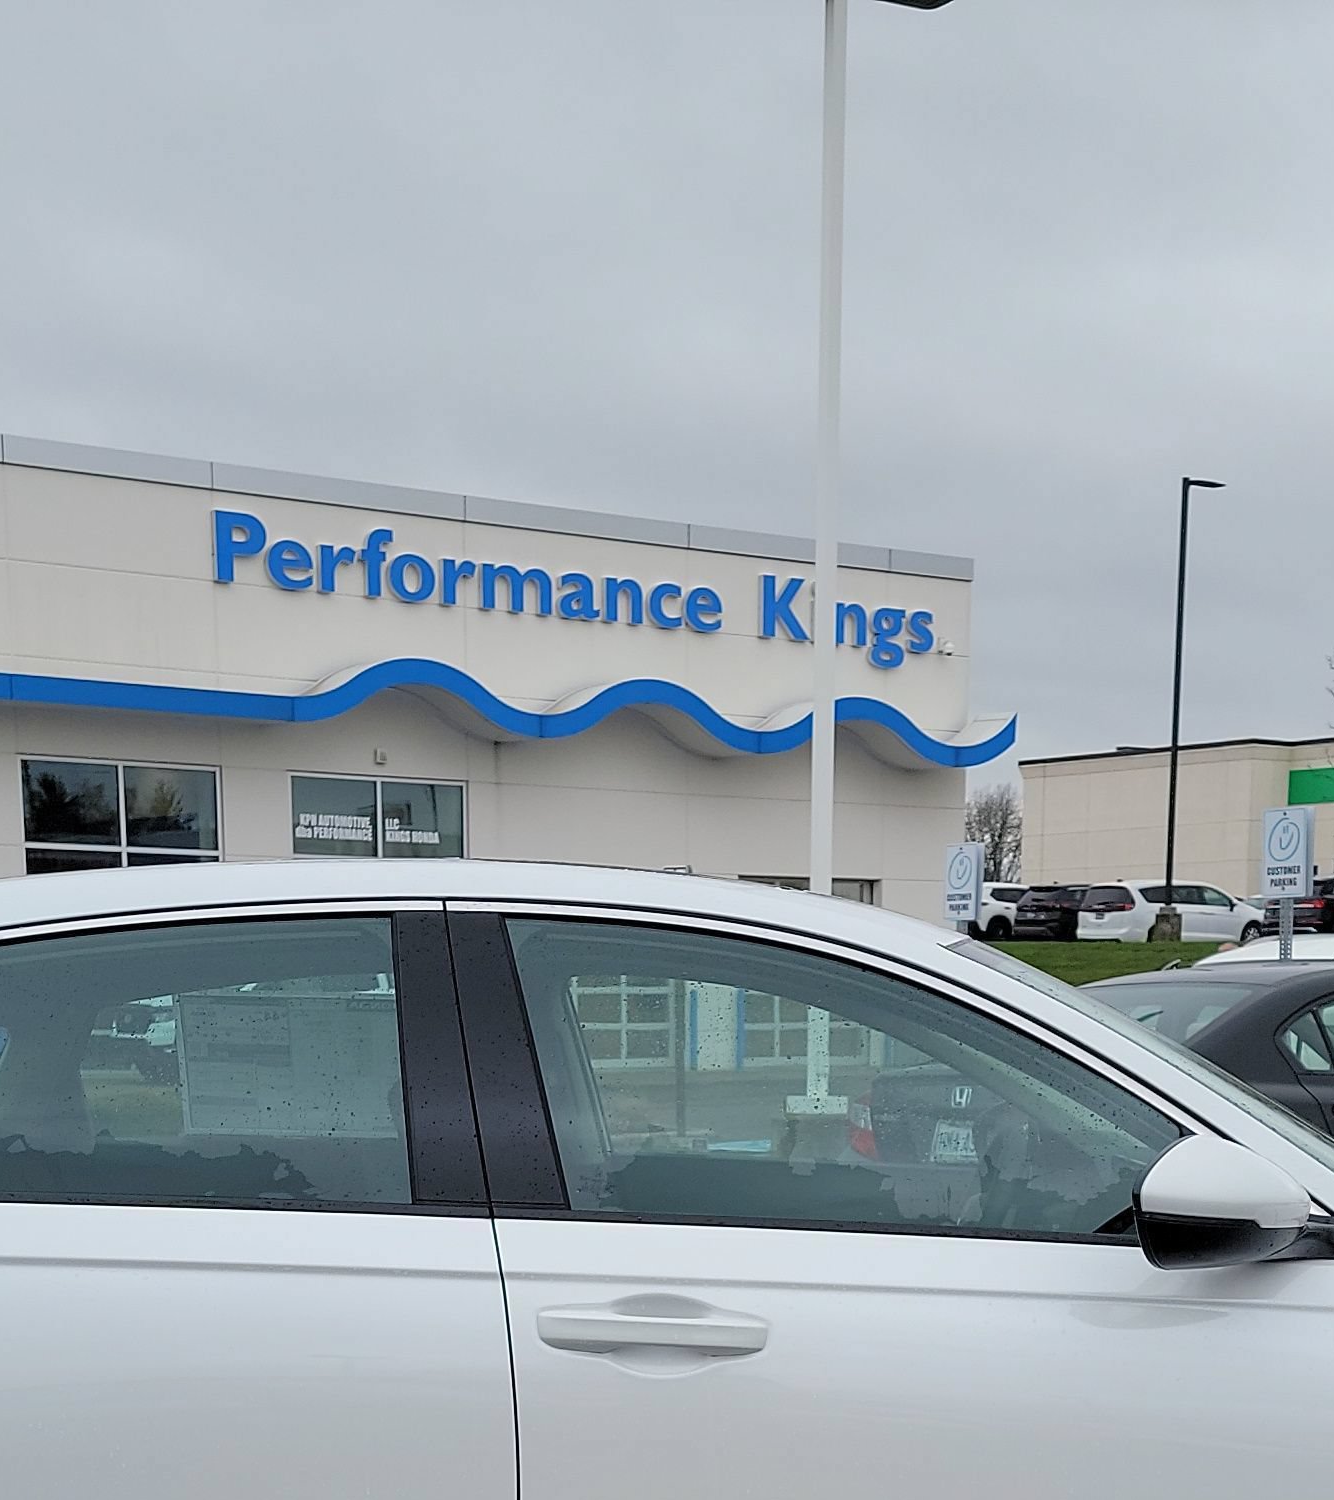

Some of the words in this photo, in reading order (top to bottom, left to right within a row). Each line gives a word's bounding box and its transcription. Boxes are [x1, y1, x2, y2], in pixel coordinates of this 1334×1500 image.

[211, 509, 723, 634] Performance
[758, 572, 935, 670] Kngs
[385, 817, 400, 830] LLC
[313, 827, 373, 841] PERFORMANCE
[385, 830, 410, 843] KINGS
[411, 831, 440, 844] HONDA
[1267, 865, 1301, 875] CUSTOMER
[1270, 878, 1297, 887] PARKING
